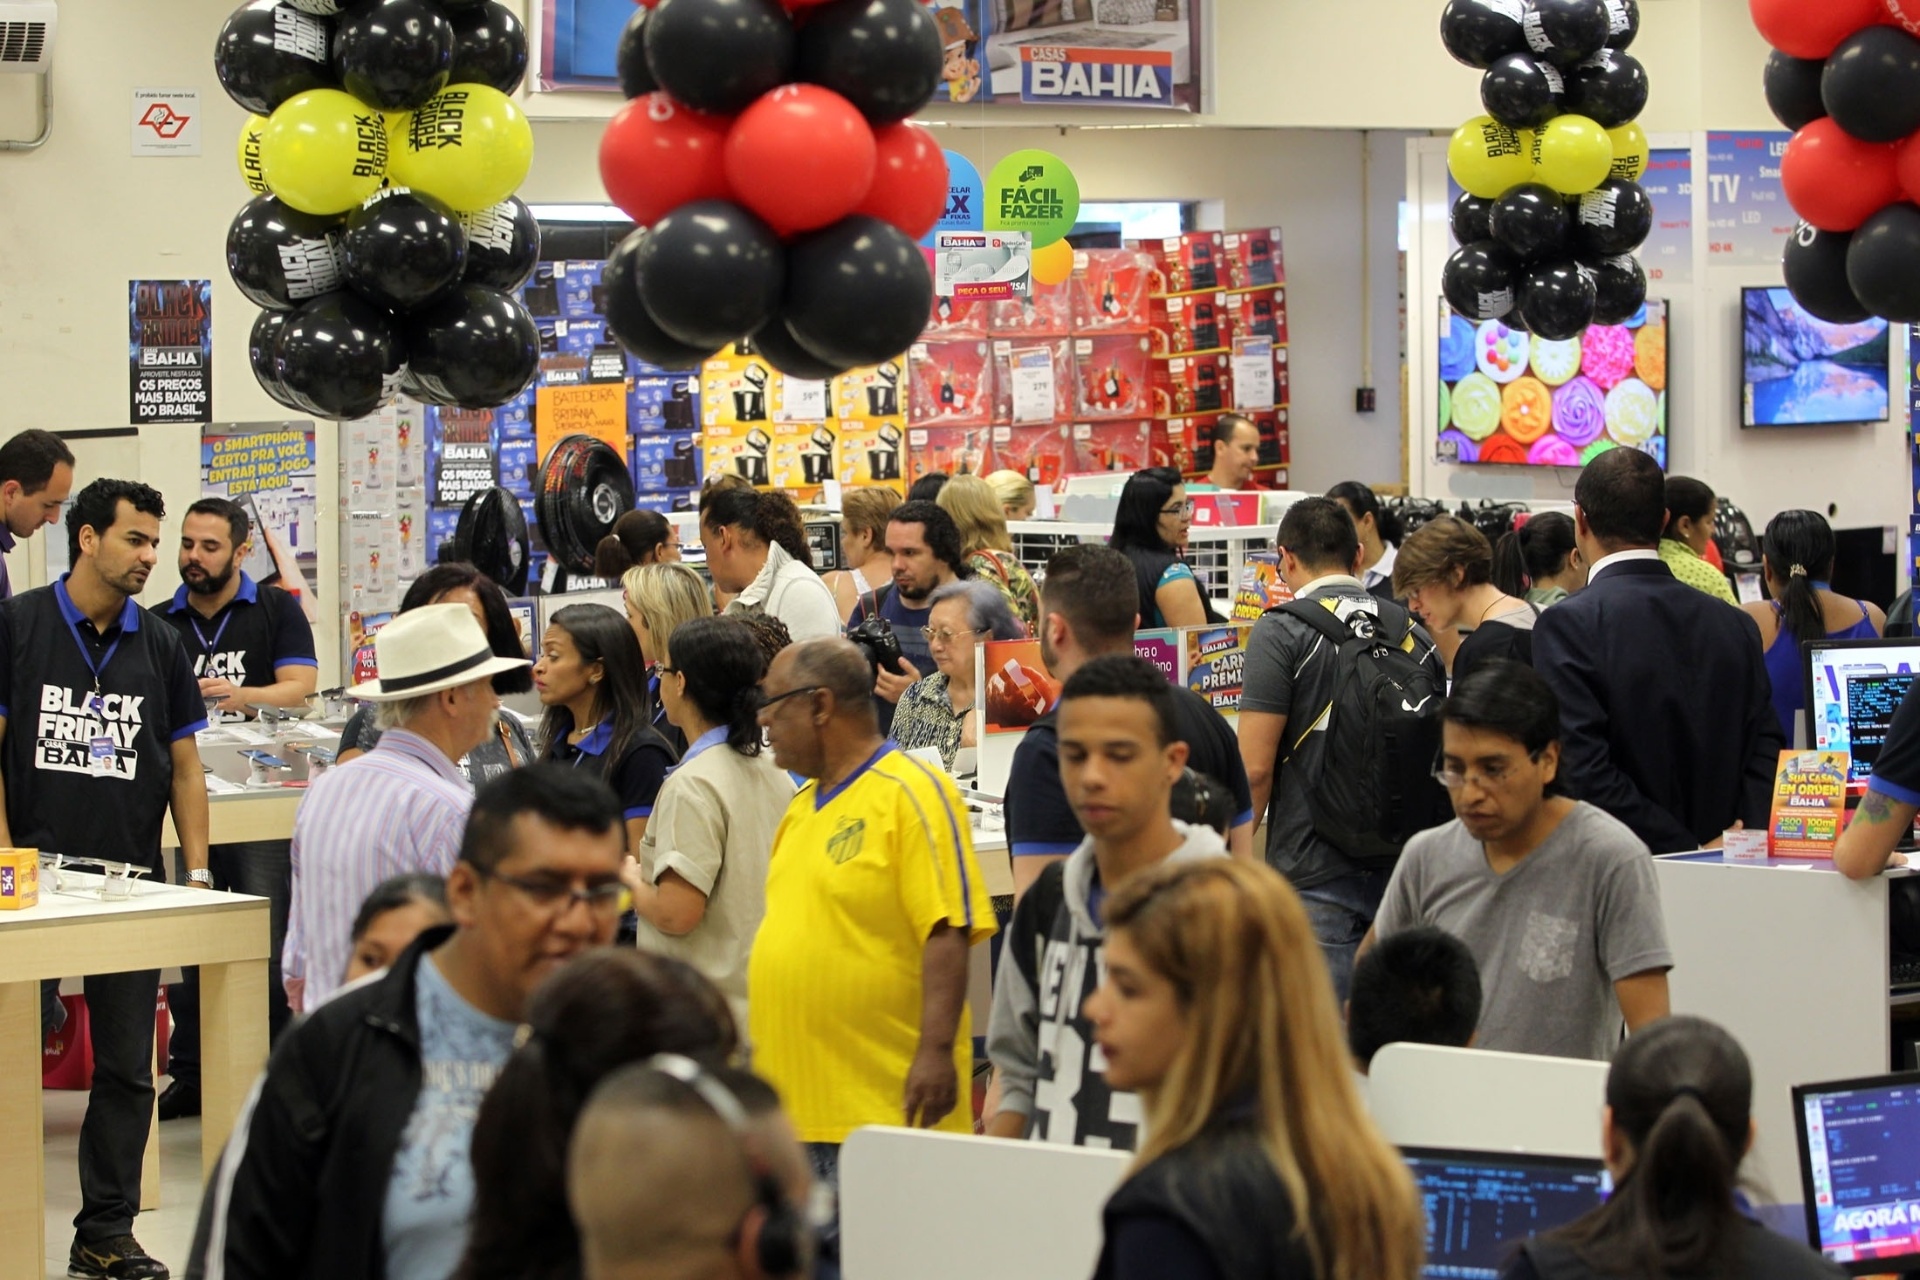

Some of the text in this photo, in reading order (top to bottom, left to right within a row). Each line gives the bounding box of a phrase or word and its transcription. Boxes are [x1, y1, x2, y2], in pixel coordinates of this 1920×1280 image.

[1030, 47, 1066, 61] CASAS
[1031, 61, 1162, 98] BAHIA
[437, 92, 469, 149] BLACK
[352, 114, 374, 177] BLACK
[1480, 122, 1503, 158] BLACK
[1001, 185, 1063, 204] FÁCIL
[1709, 174, 1740, 203] TV
[1001, 205, 1063, 219] FAZER
[1742, 210, 1761, 224] LED
[943, 239, 976, 247] BAHIA
[277, 243, 309, 299] BLACK
[957, 285, 979, 297] PEÇA
[981, 286, 987, 294] O
[137, 285, 206, 318] BLACK
[144, 352, 197, 365] BAHIA
[140, 379, 202, 394] OS PREÇOS
[135, 391, 206, 404] MAIS BAIXOS
[140, 404, 202, 416] DO BRASIL.
[213, 431, 306, 453] O SMARTPHONE
[211, 440, 306, 467] CERTO PRA VOCÊ
[445, 447, 487, 459] BAHIA
[209, 456, 311, 483] ENTRAR NO JOGO
[442, 469, 492, 482] OS PREÇOS
[228, 474, 291, 495] ESTÁ AQUI.
[438, 480, 461, 491] MAIS
[442, 491, 456, 501] DO
[567, 577, 607, 591] BAHIA
[1202, 641, 1228, 655] BAHIA
[41, 684, 145, 723] BLACK
[38, 712, 142, 748] FRIDAY
[44, 740, 68, 749] CASAS
[1780, 784, 1840, 796] EM ORDEM
[1790, 798, 1825, 806] BAHIA
[1833, 1206, 1908, 1233] AGORA
